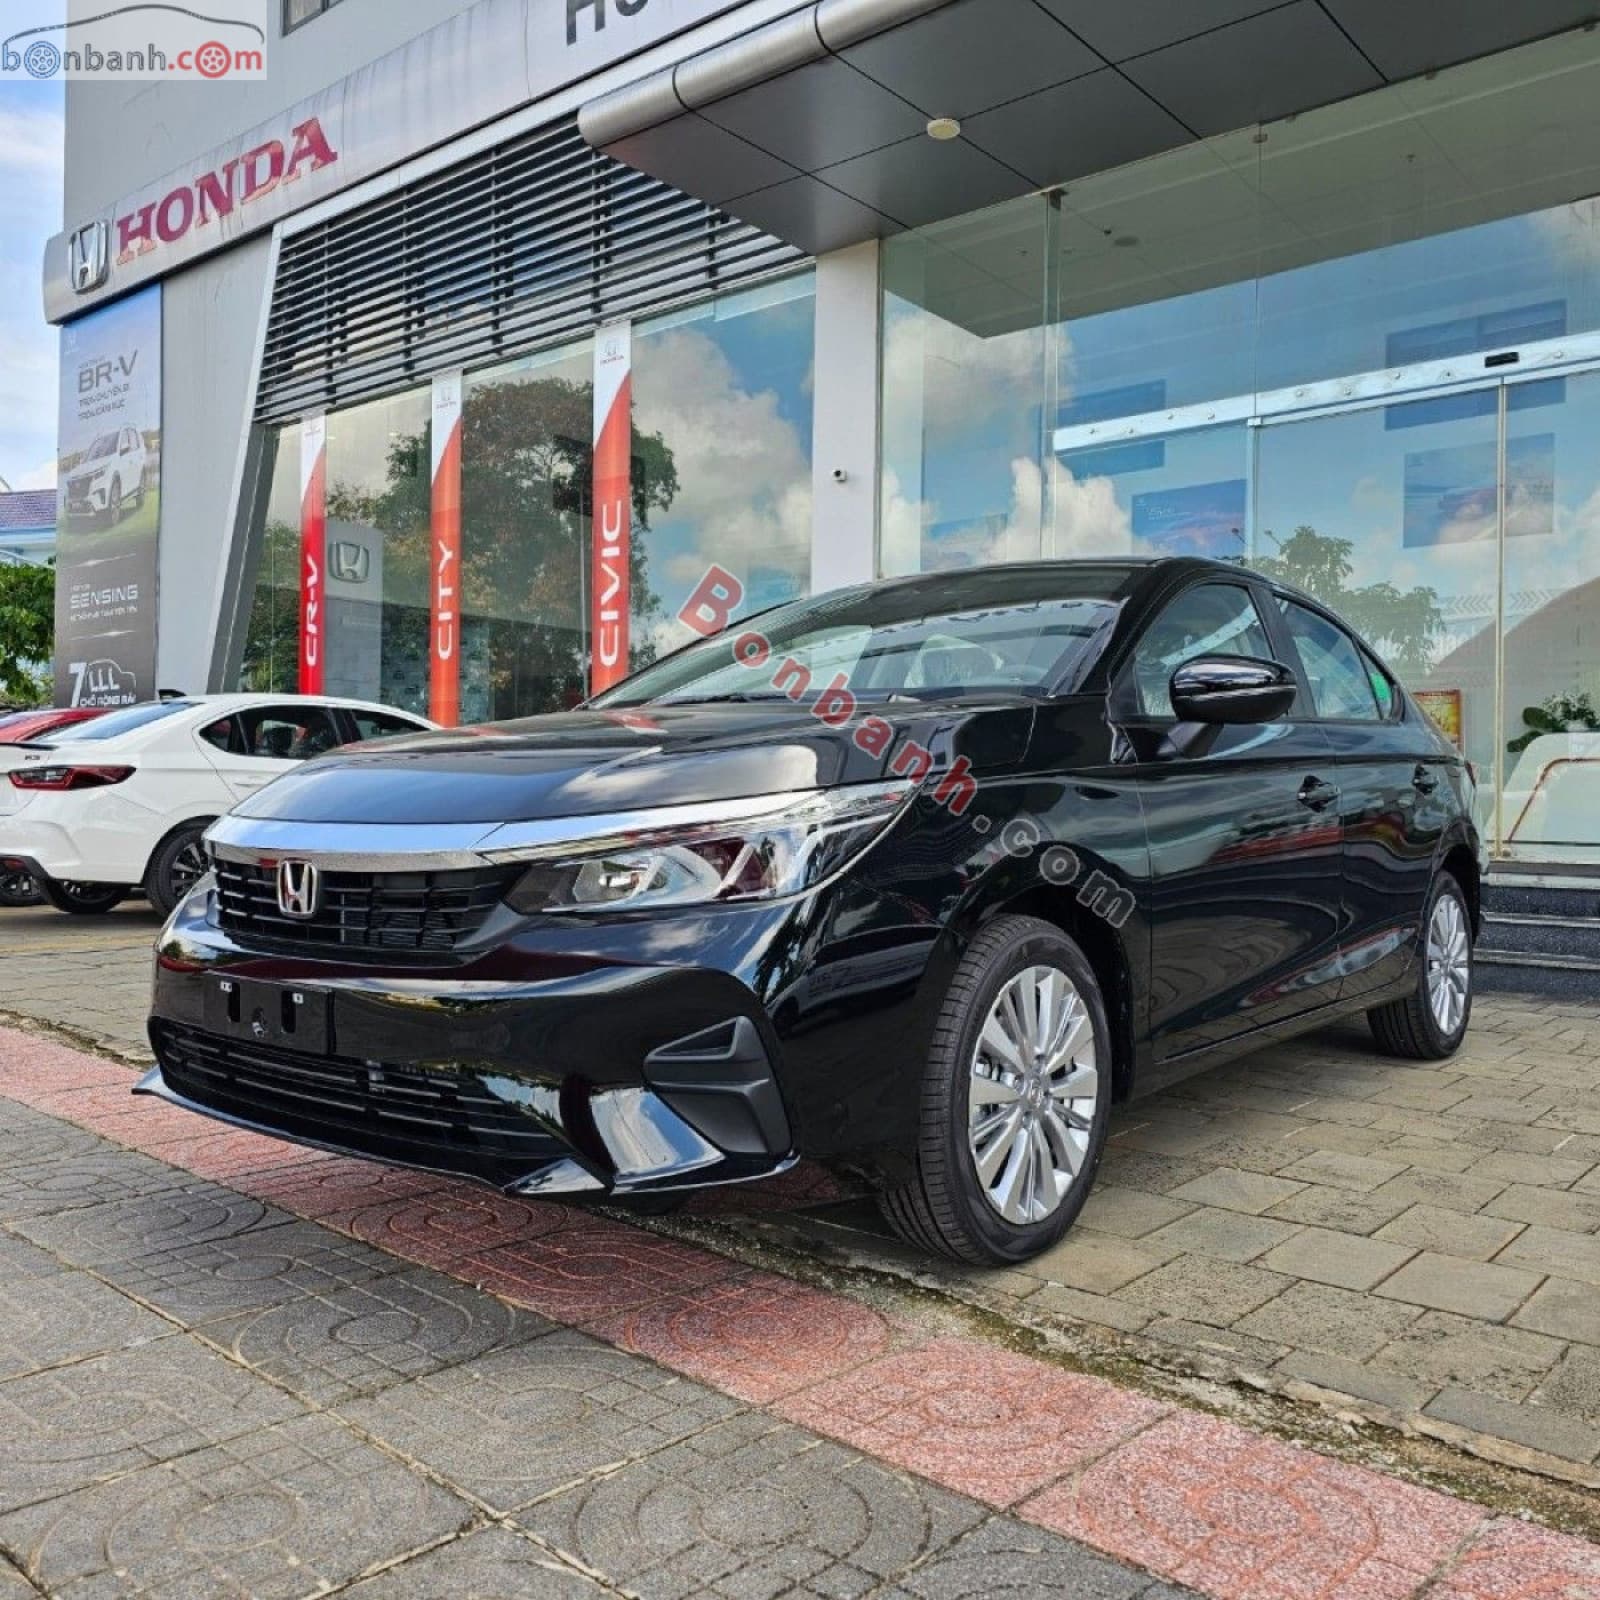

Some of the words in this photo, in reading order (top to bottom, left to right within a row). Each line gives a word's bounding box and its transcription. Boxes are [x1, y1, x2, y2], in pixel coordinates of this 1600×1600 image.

[116, 117, 338, 266] HONDA
[78, 348, 138, 394] BR-V
[69, 583, 138, 609] SENSING
[305, 554, 317, 667] CR-V
[437, 540, 454, 660] CITY
[599, 500, 622, 667] CIVIC
